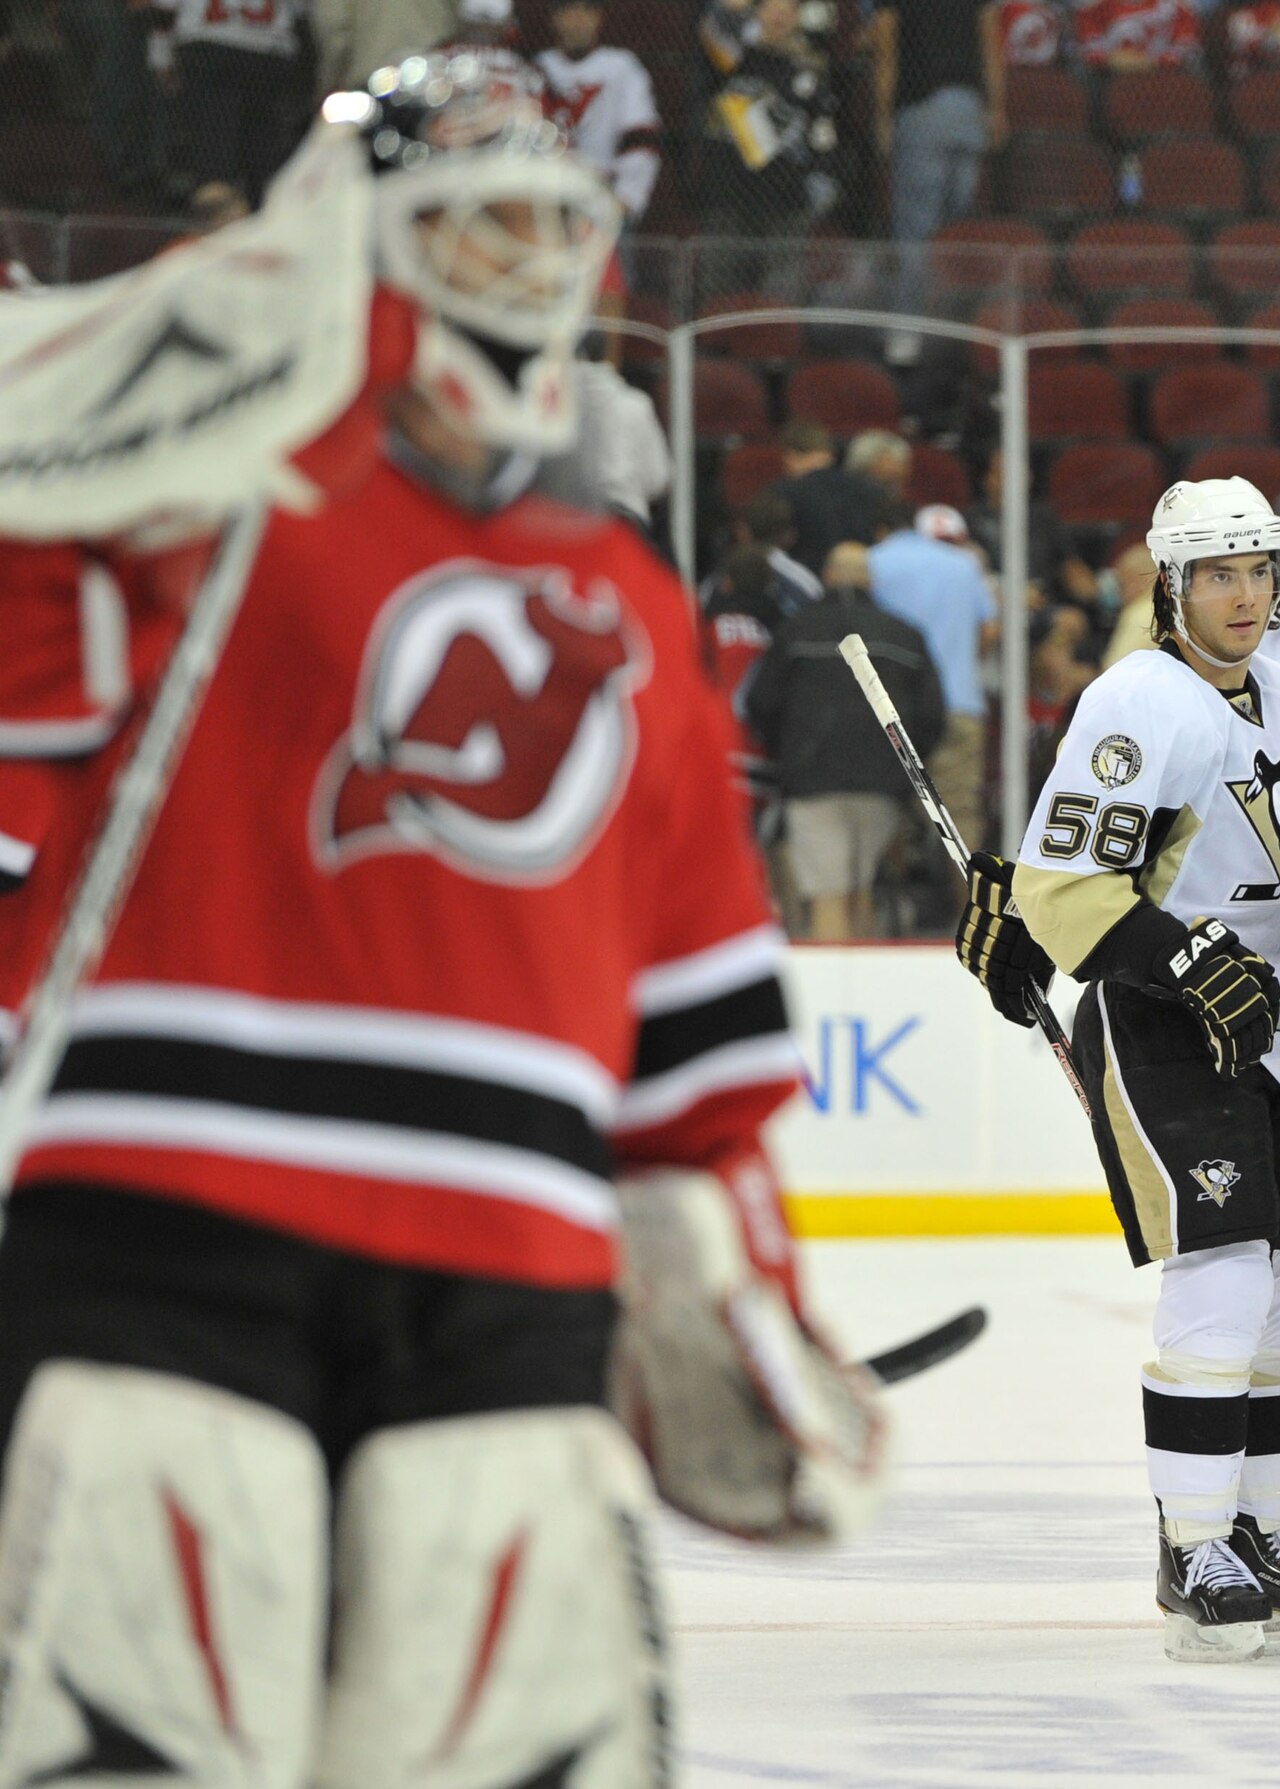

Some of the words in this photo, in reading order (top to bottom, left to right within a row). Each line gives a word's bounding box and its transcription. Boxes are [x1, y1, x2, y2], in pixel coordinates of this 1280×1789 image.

[1223, 528, 1262, 539] BAUER
[1039, 792, 1150, 869] 58
[1168, 919, 1227, 979] EAS
